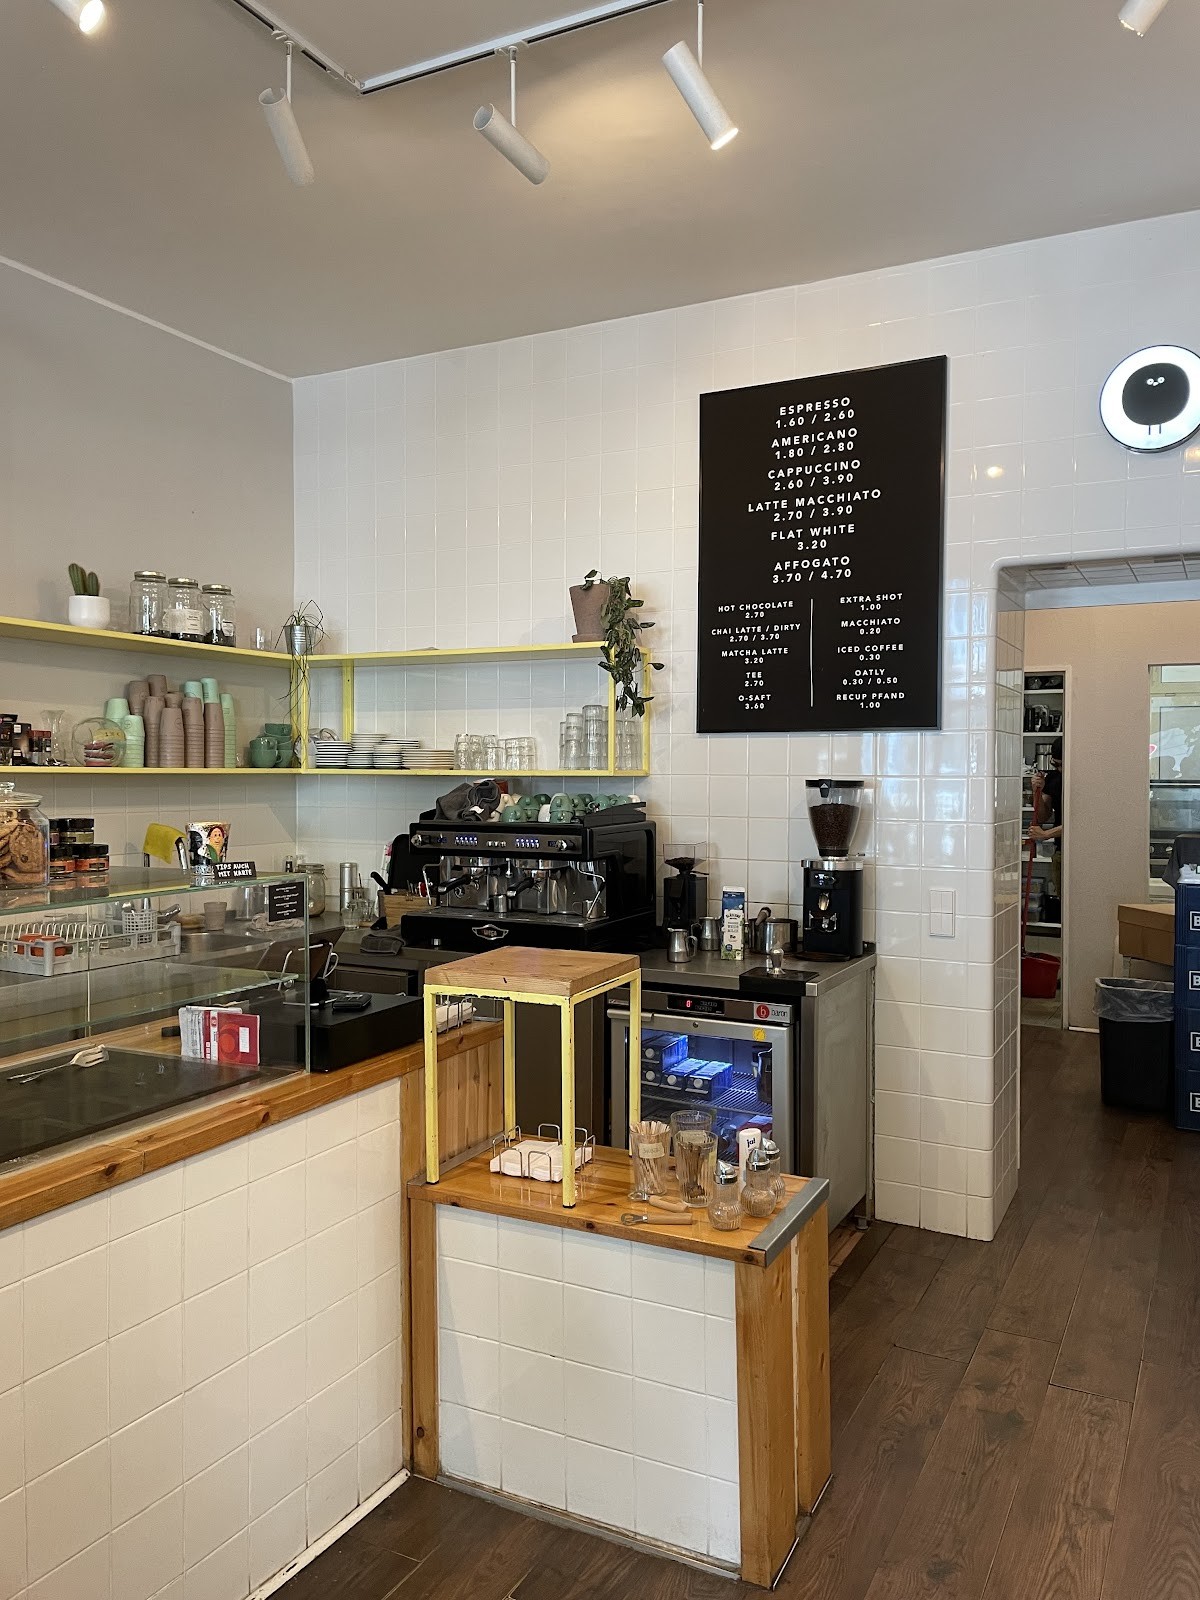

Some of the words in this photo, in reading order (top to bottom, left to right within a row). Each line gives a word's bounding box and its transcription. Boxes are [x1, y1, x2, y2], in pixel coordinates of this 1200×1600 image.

[780, 397, 850, 416] ESPRESSO
[776, 417, 804, 428] 1.60
[811, 414, 817, 424] /
[824, 409, 854, 422] 2.60
[771, 428, 858, 448] AMERICANO
[775, 448, 803, 459] 1.80
[811, 446, 816, 455] /
[823, 441, 854, 453] 2.80
[768, 460, 860, 480] CAPPUCCINO
[774, 479, 803, 491] 2.60
[810, 477, 815, 487] /
[823, 473, 853, 485] 3.90
[748, 500, 787, 512] LATTE
[796, 489, 881, 508] MACCHIATO
[774, 510, 802, 522] 2.70
[810, 508, 815, 518] /
[823, 505, 852, 516] 3.90
[771, 529, 803, 540] FLAT
[810, 524, 854, 537] WHITE
[797, 539, 827, 550] 3.20
[774, 556, 851, 572] AFFOGATO
[773, 573, 801, 583] 3.70
[808, 571, 814, 581] /
[821, 569, 851, 579] 4.70
[840, 596, 871, 604] EXTRA
[876, 593, 902, 601] SHOT
[739, 601, 793, 610] CHOCOLATE
[860, 603, 881, 611] 1.00
[774, 623, 800, 631] DIRTY
[841, 618, 900, 627] MACCHIATO
[860, 627, 881, 635] 0.20
[722, 649, 757, 657] MATCHA
[865, 644, 903, 652] COFFEE
[233, 862, 250, 870] AUCH
[233, 869, 252, 877] KARTE
